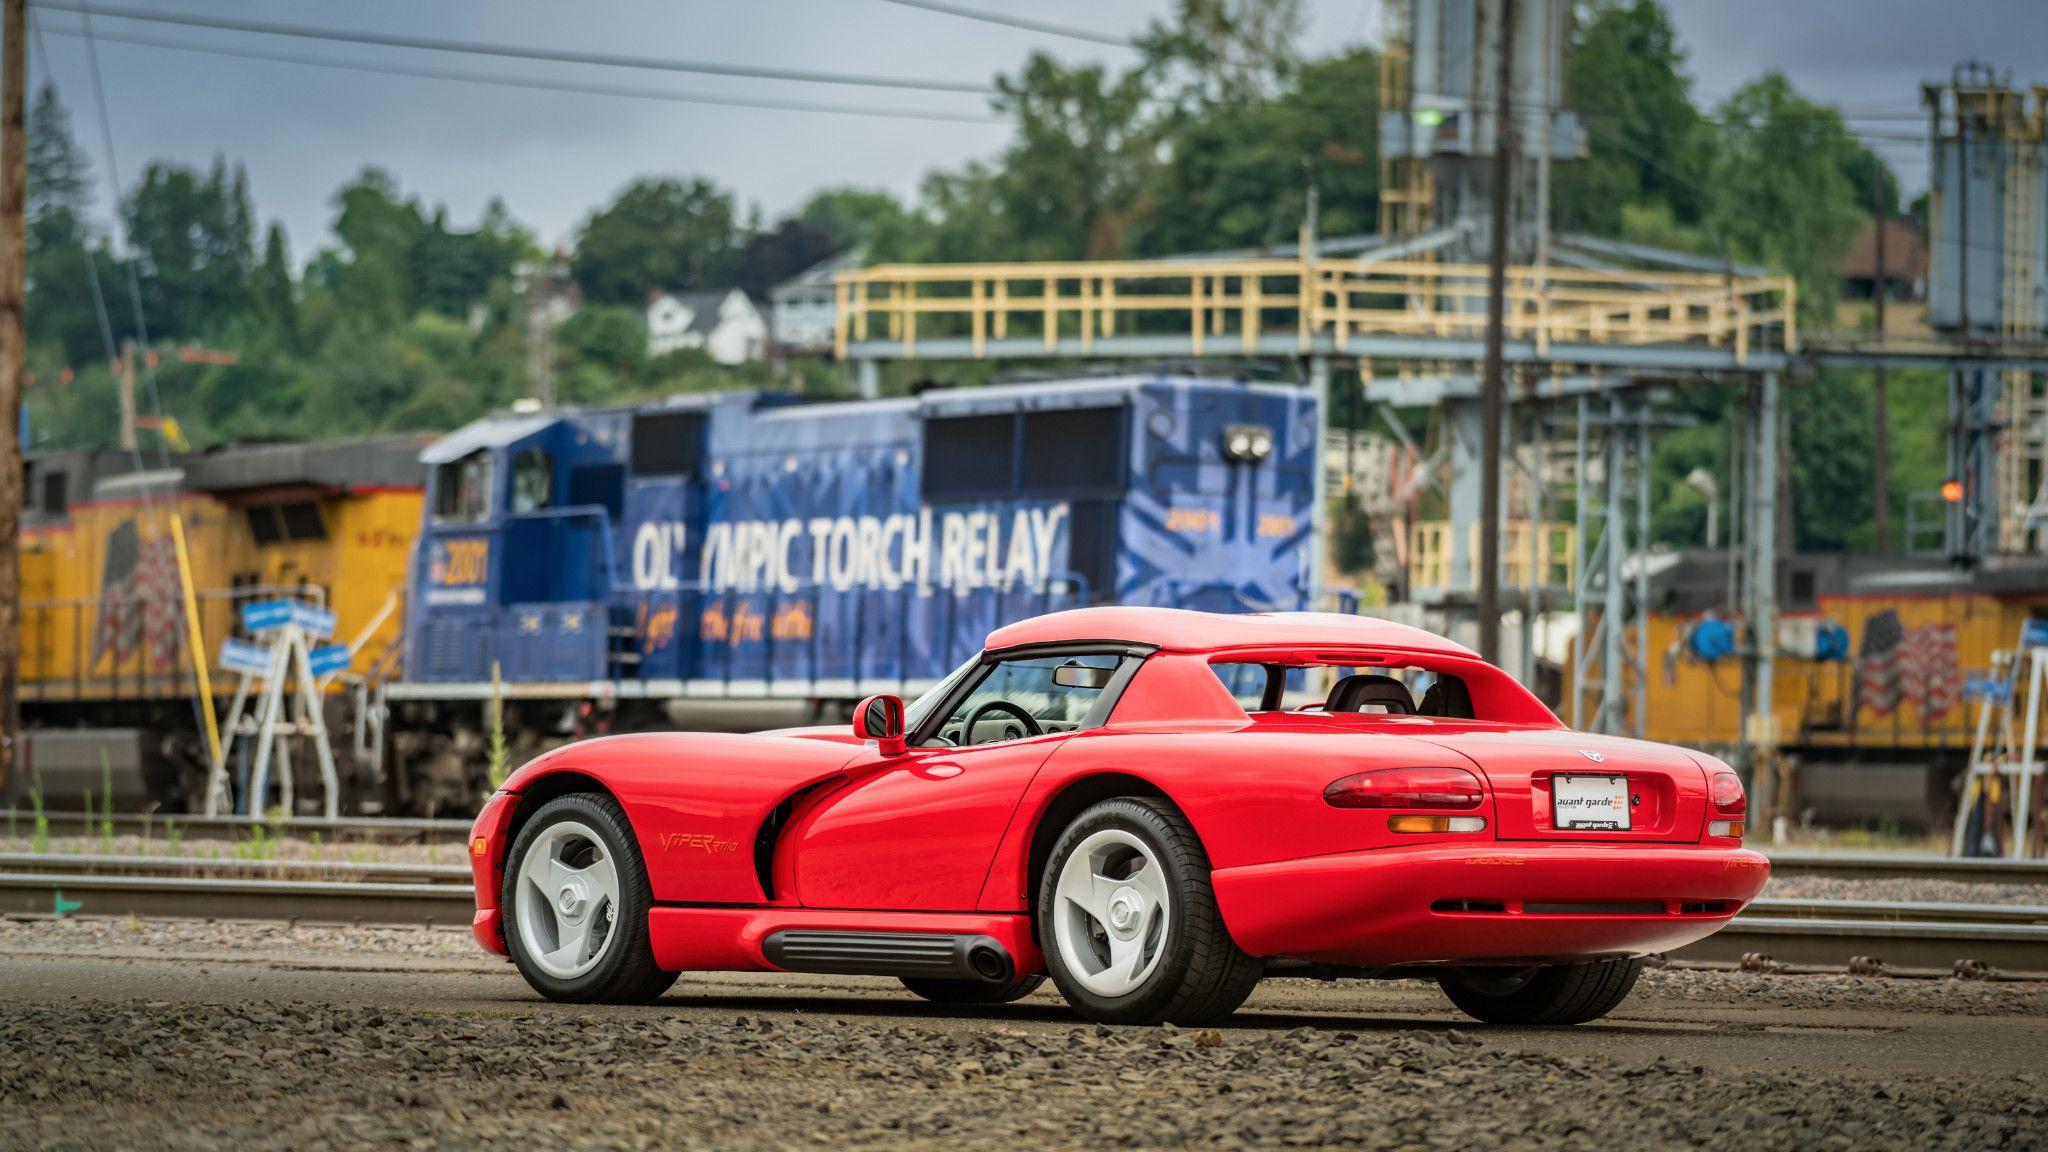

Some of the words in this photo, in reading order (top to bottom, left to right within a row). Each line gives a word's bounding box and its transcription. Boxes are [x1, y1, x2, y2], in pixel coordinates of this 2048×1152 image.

[808, 507, 933, 597] TORCH
[941, 503, 1069, 598] RELAY
[1585, 797, 1613, 809] garde
[659, 832, 714, 854] VIPER
